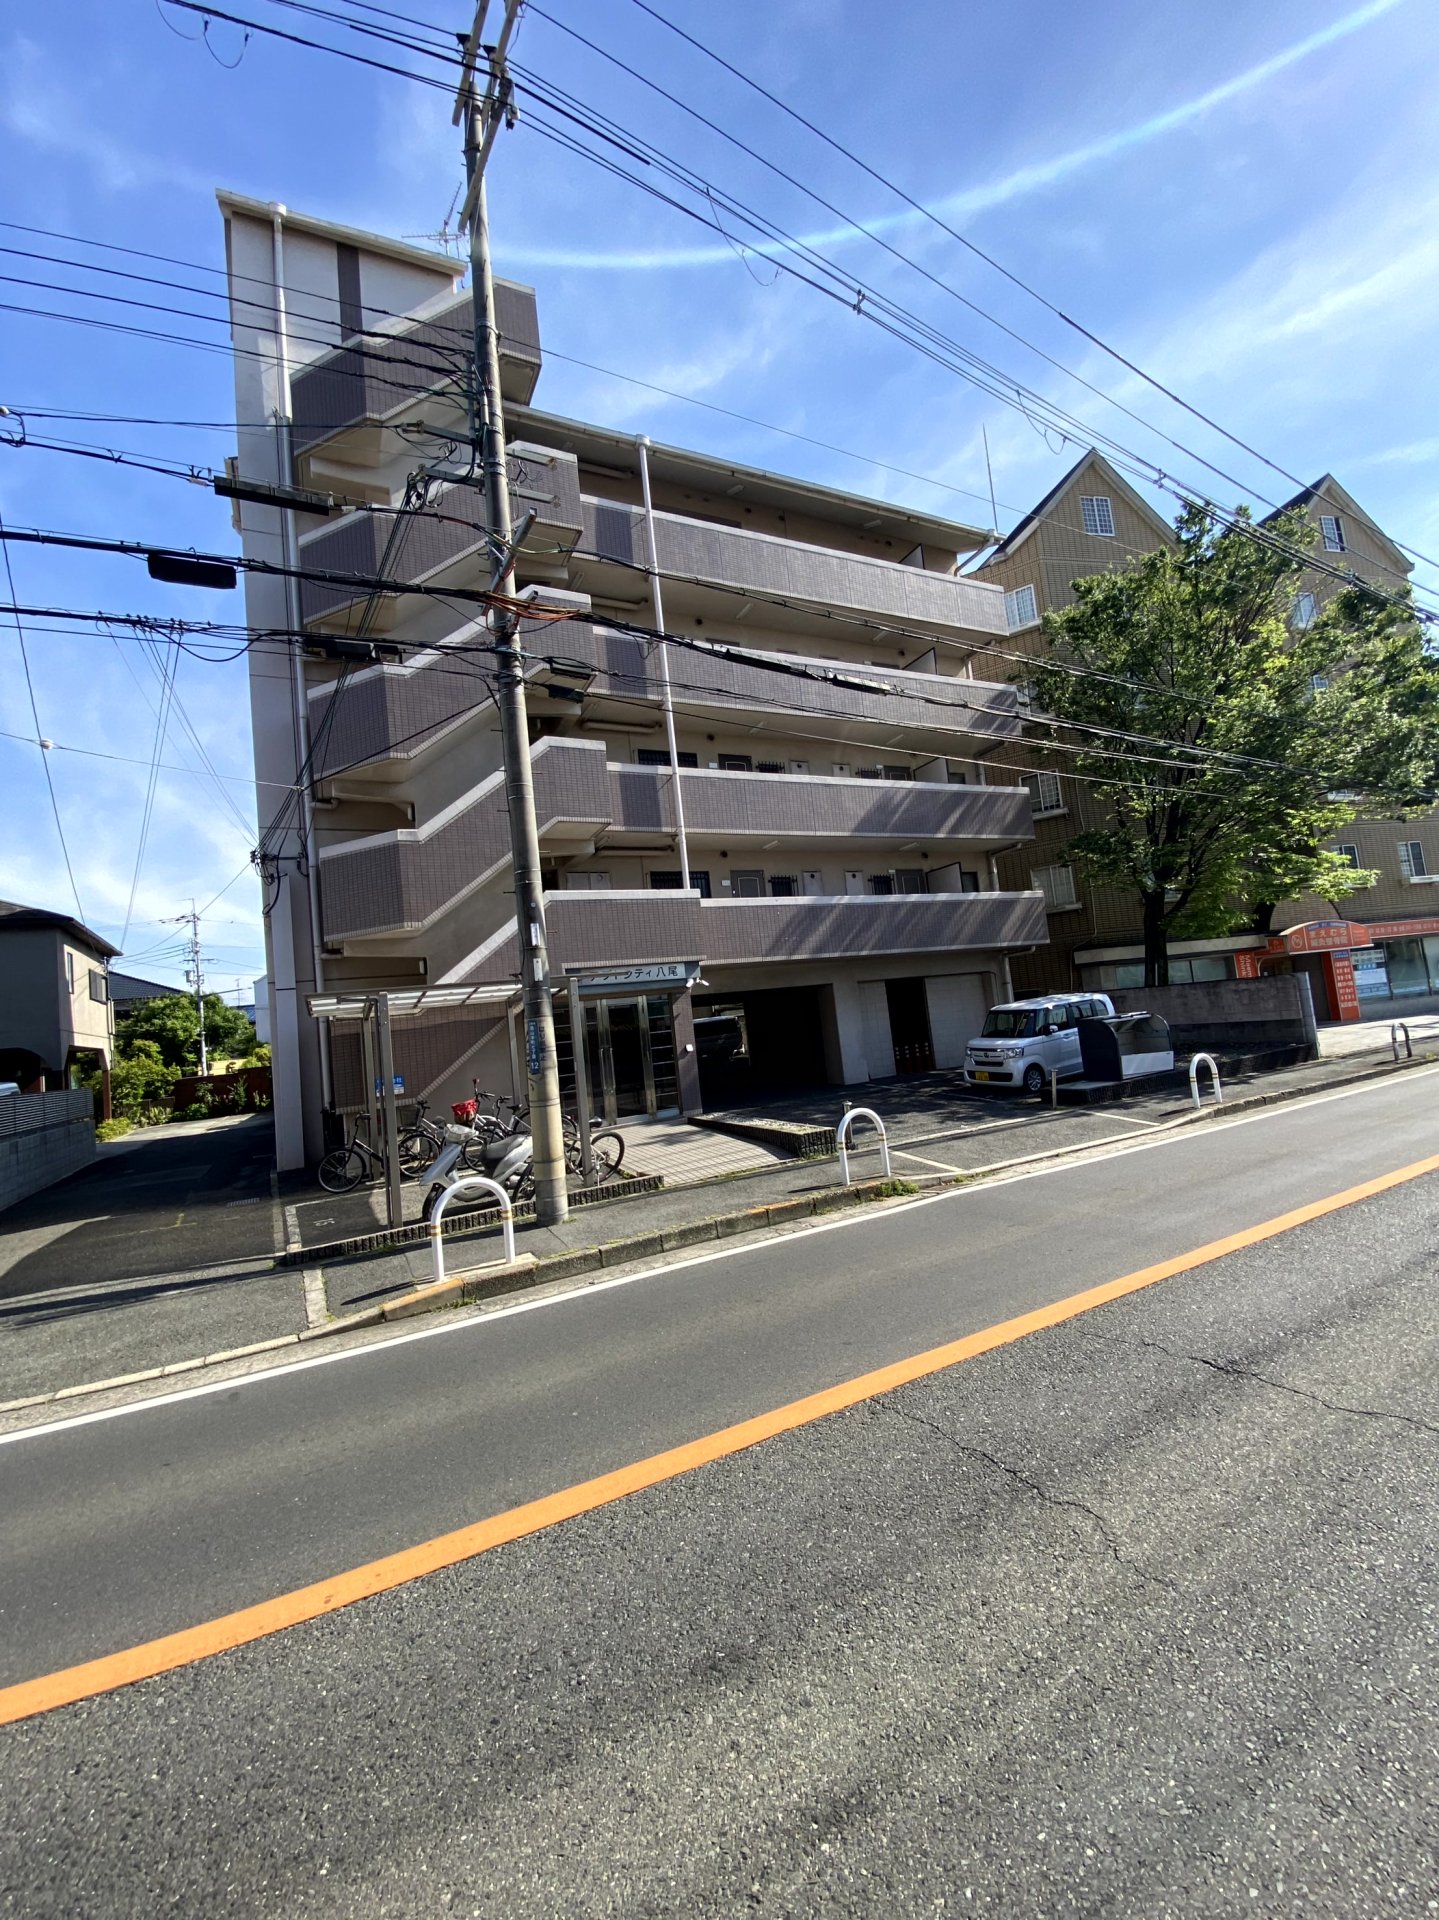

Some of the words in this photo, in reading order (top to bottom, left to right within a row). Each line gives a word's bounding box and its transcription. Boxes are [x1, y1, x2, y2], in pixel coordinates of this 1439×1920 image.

[1309, 927, 1347, 938] まえむら
[530, 1062, 539, 1070] 12
